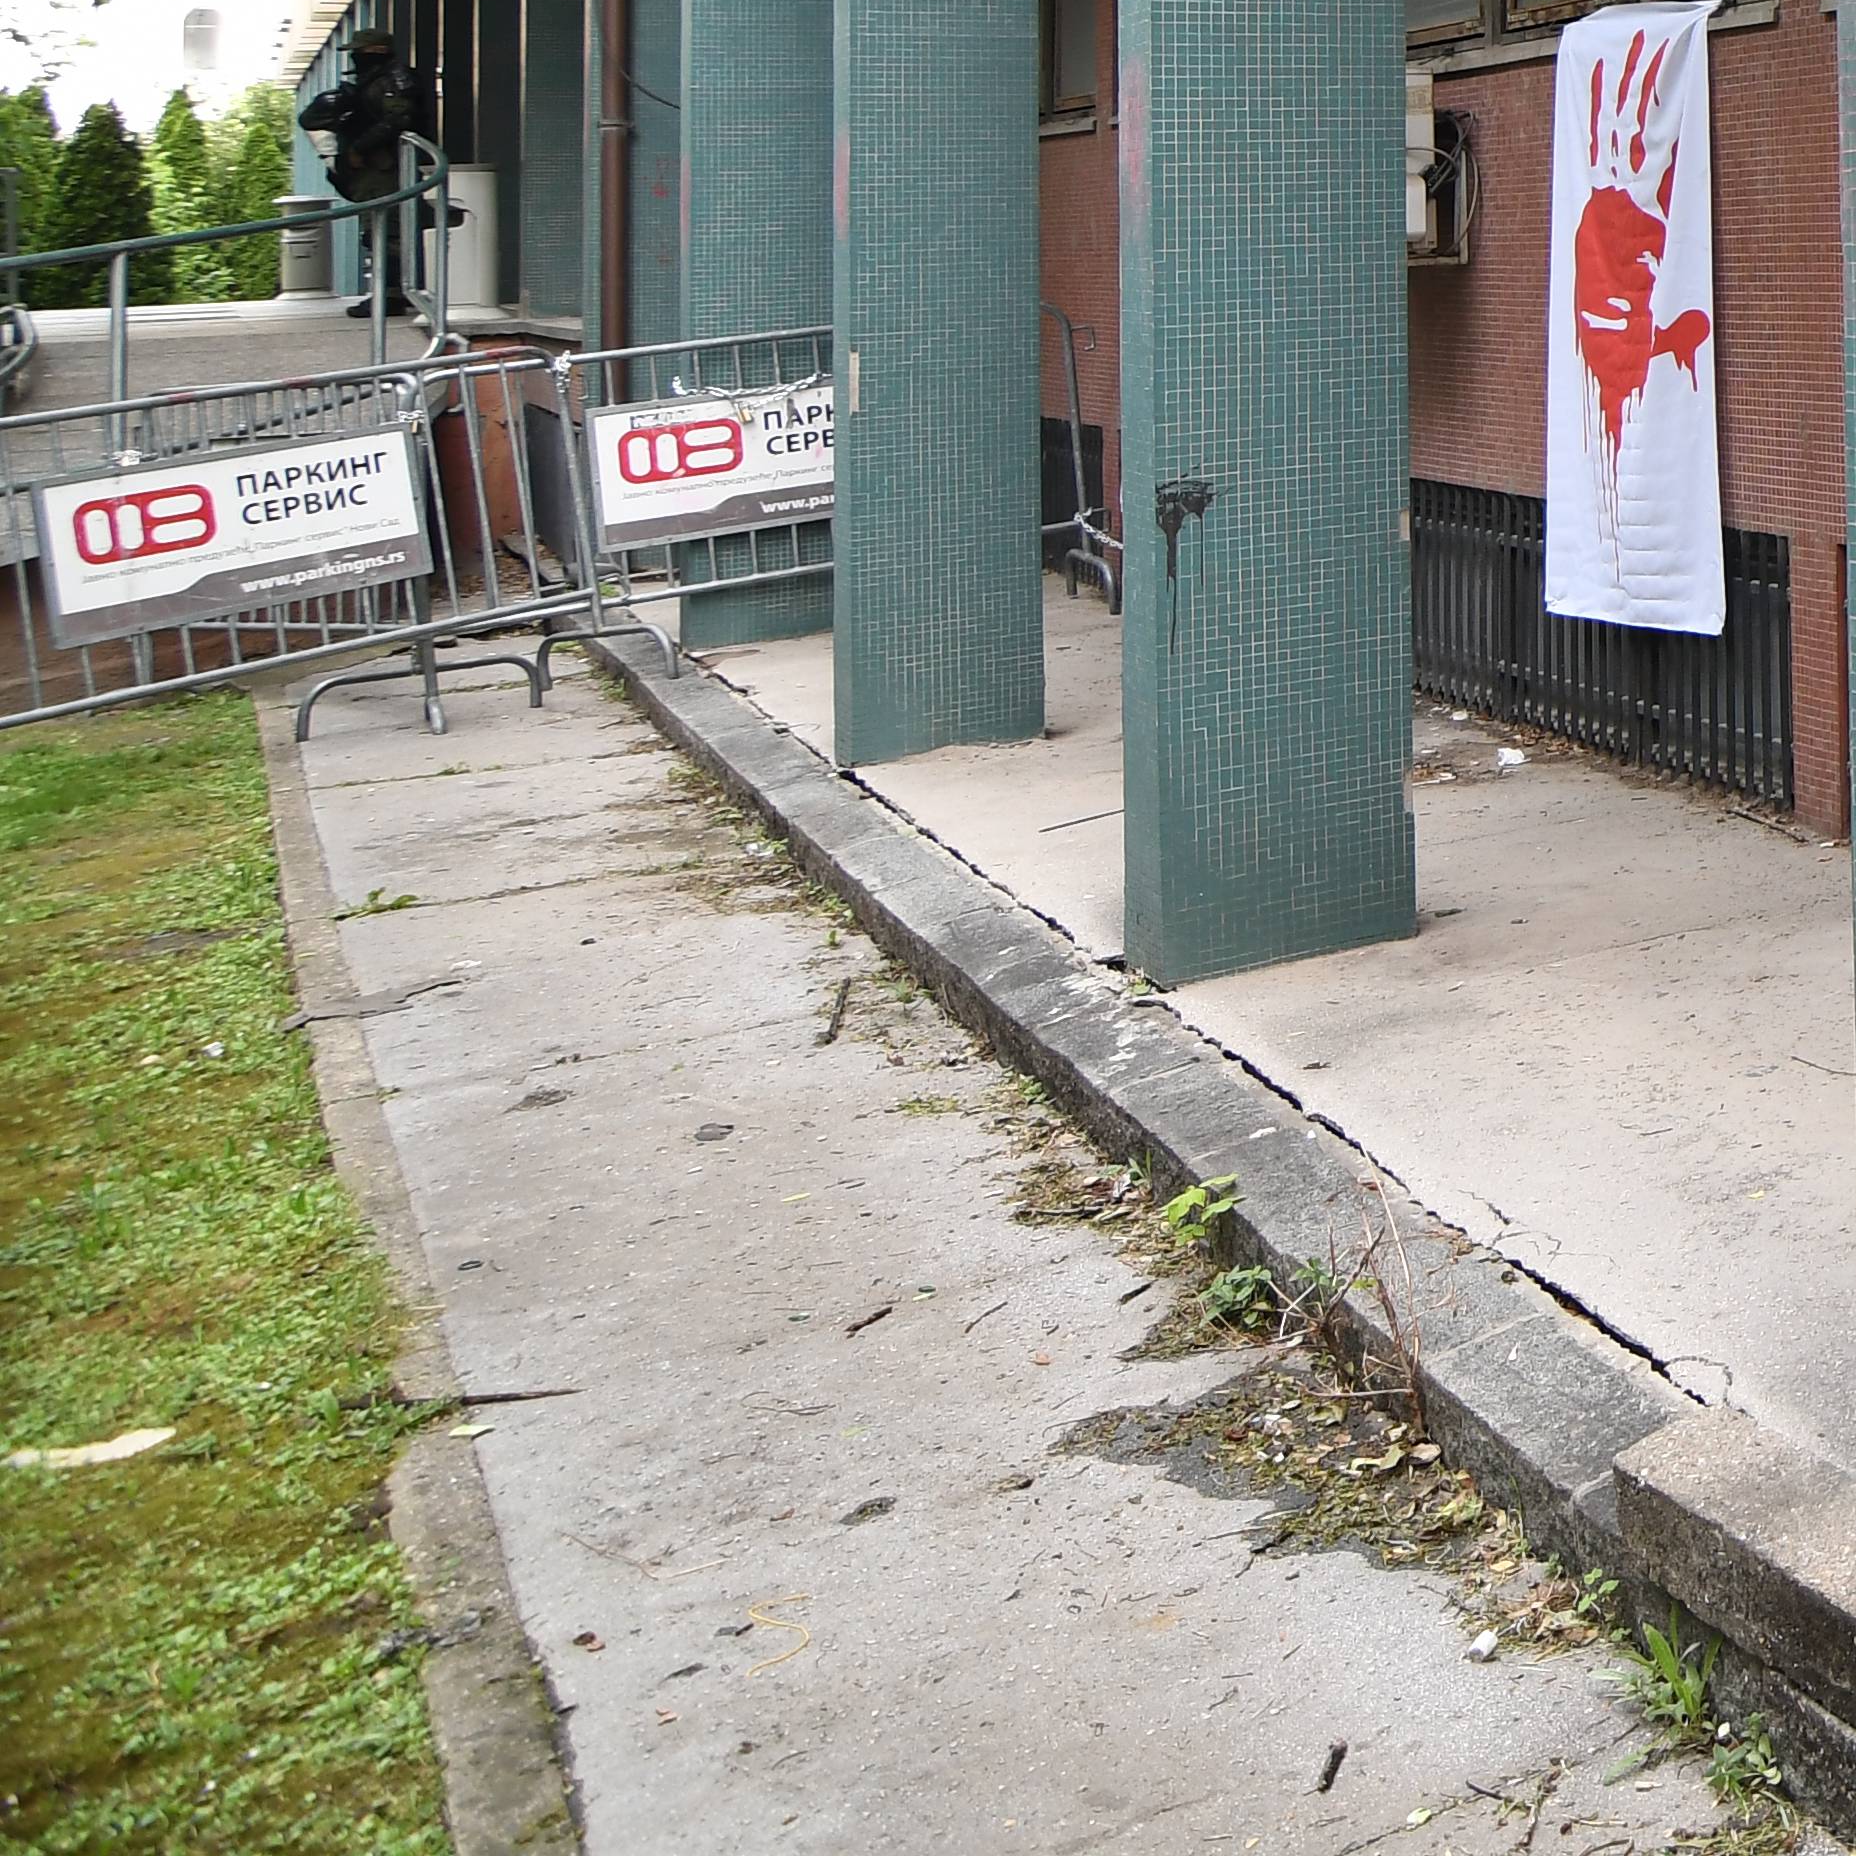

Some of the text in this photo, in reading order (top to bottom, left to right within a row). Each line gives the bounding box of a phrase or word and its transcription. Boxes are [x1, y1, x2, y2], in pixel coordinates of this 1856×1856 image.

[236, 451, 388, 498] ПАРКИНГ
[242, 483, 369, 525] СЕРВИС
[239, 549, 407, 593] www.parkingns.rs
